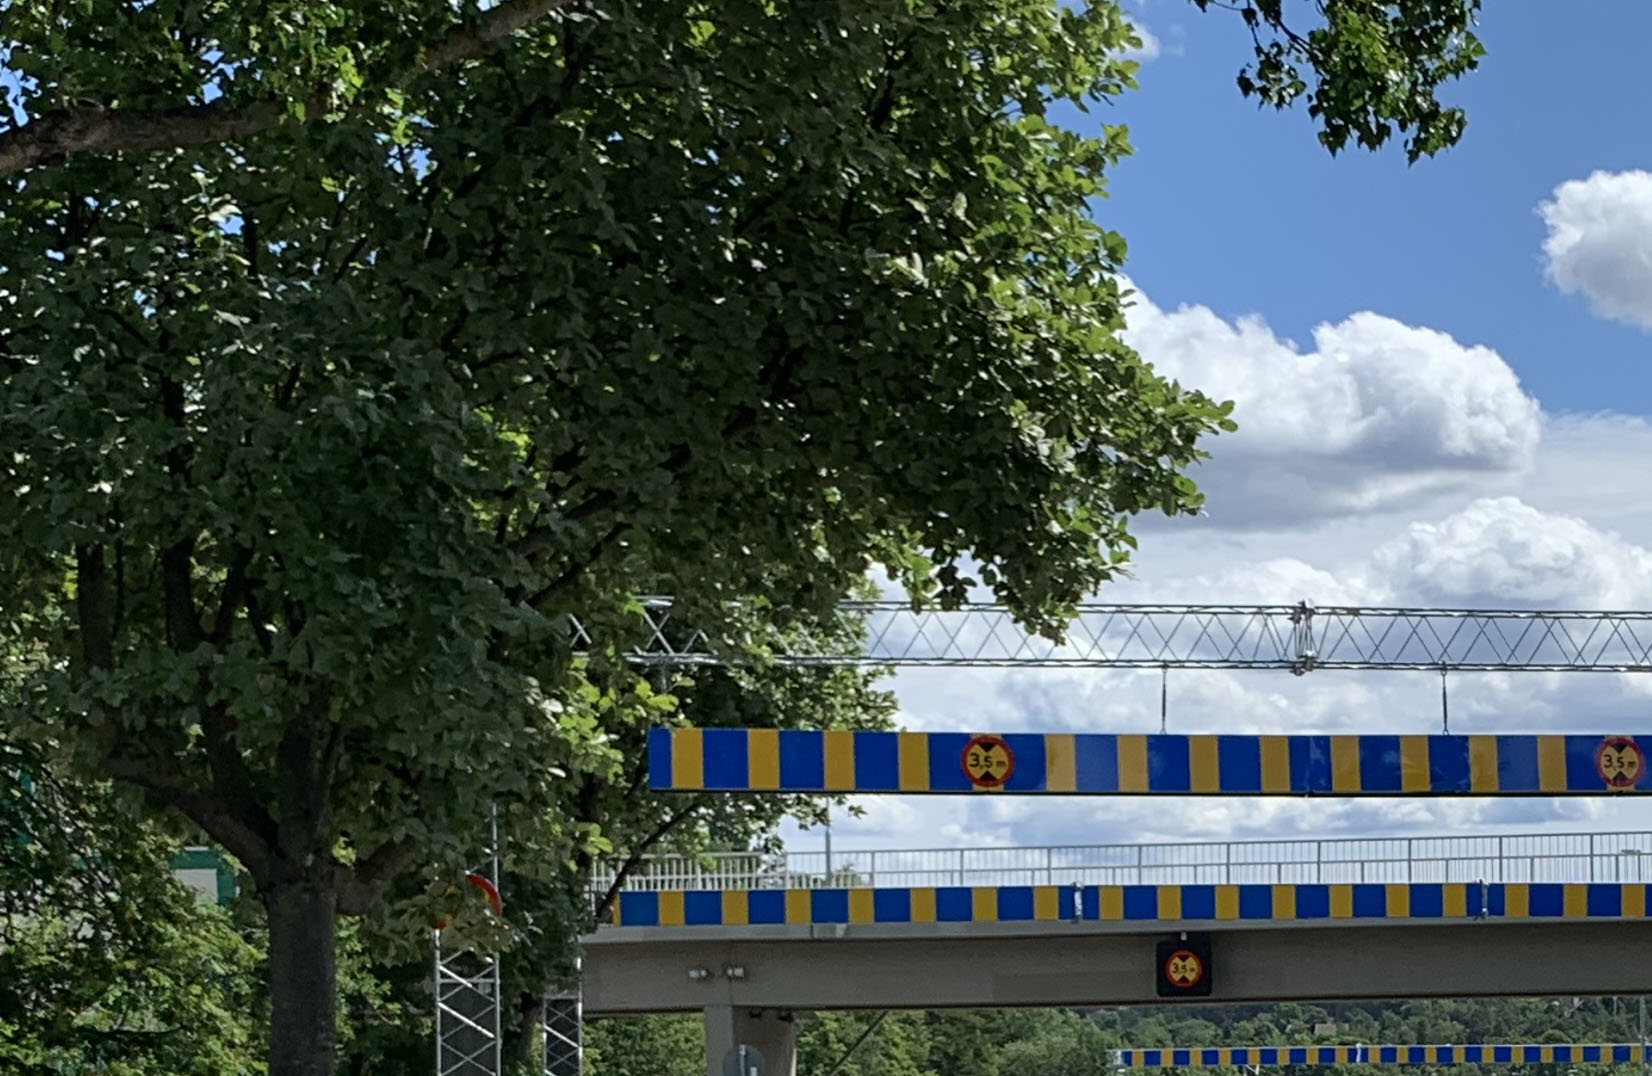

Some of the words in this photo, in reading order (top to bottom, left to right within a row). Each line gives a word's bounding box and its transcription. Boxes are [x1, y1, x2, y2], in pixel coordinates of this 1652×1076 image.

[969, 752, 993, 770] 3,5
[996, 760, 1006, 768] m
[1603, 754, 1625, 771] 3,5
